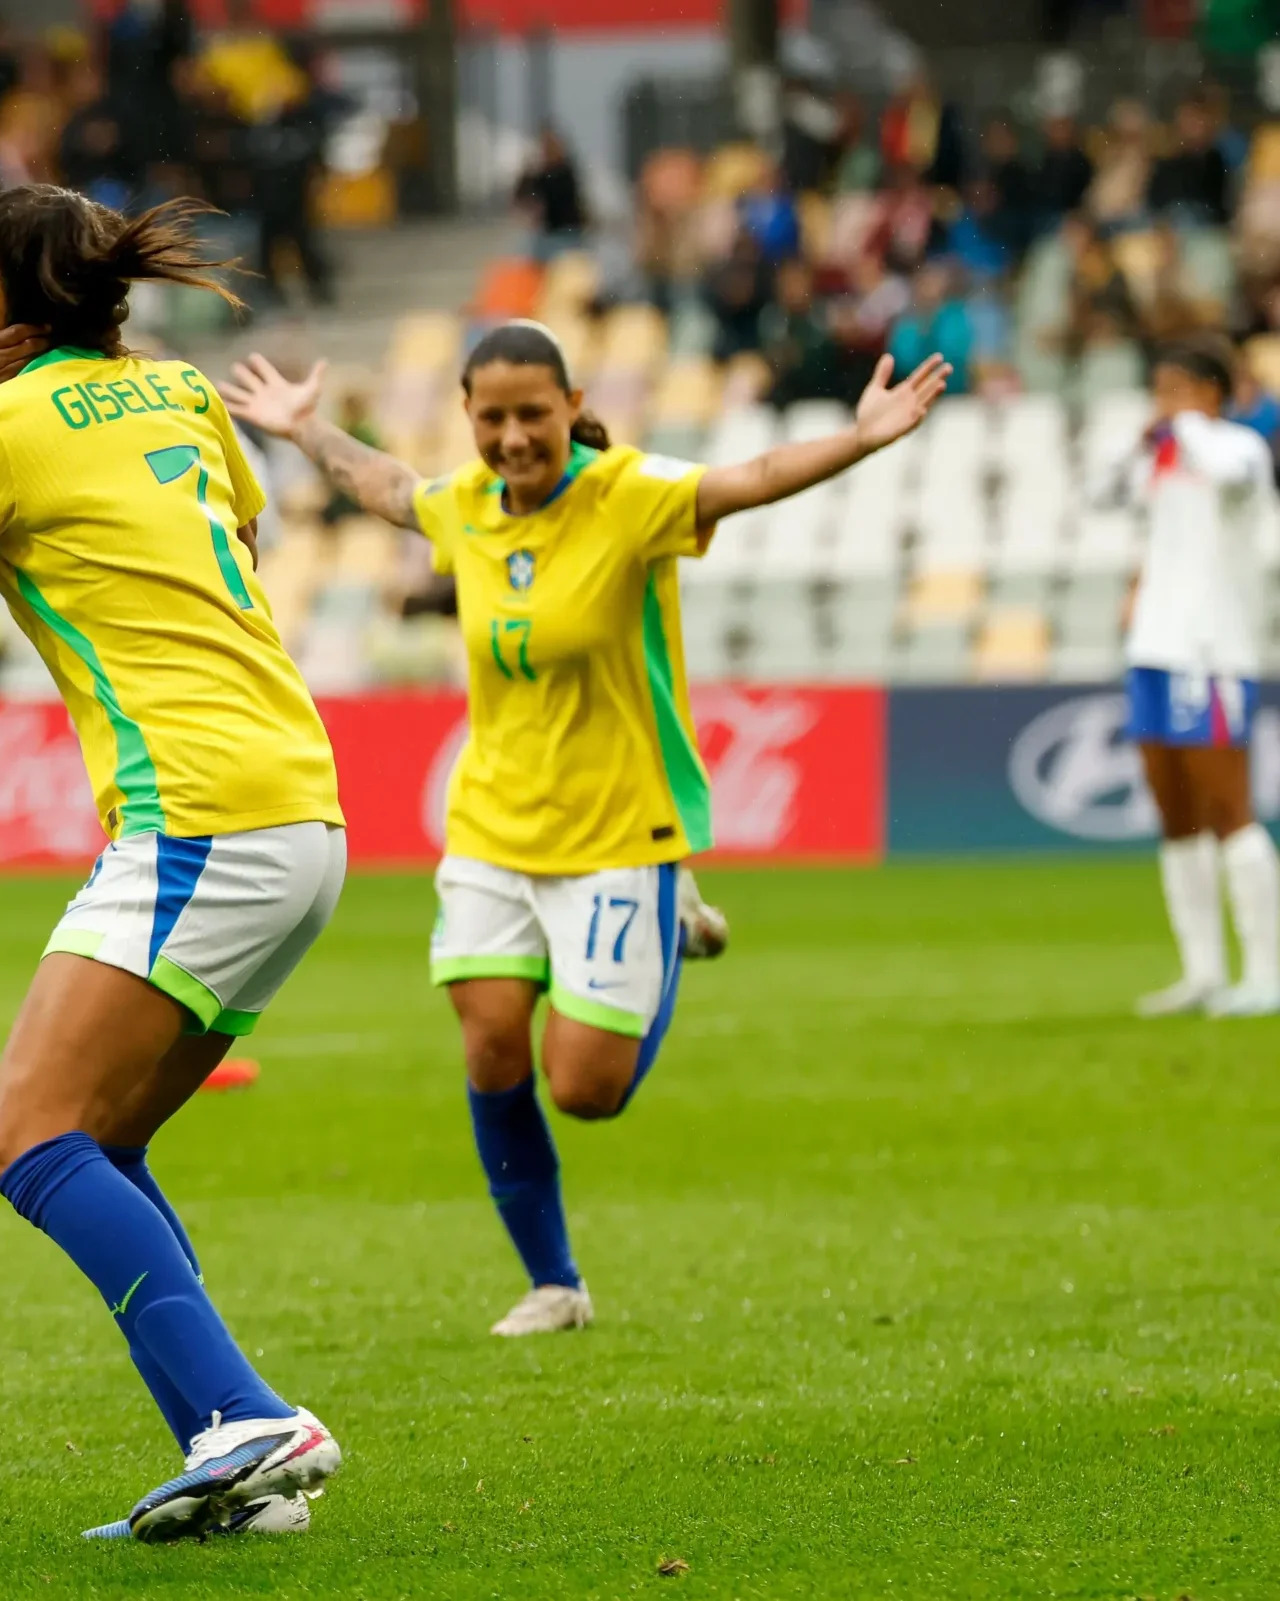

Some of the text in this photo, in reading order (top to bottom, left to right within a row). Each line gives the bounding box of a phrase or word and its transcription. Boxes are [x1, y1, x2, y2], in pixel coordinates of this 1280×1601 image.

[181, 370, 210, 414] S
[144, 445, 254, 610] 7
[491, 619, 537, 682] 17
[585, 895, 639, 962] 17
